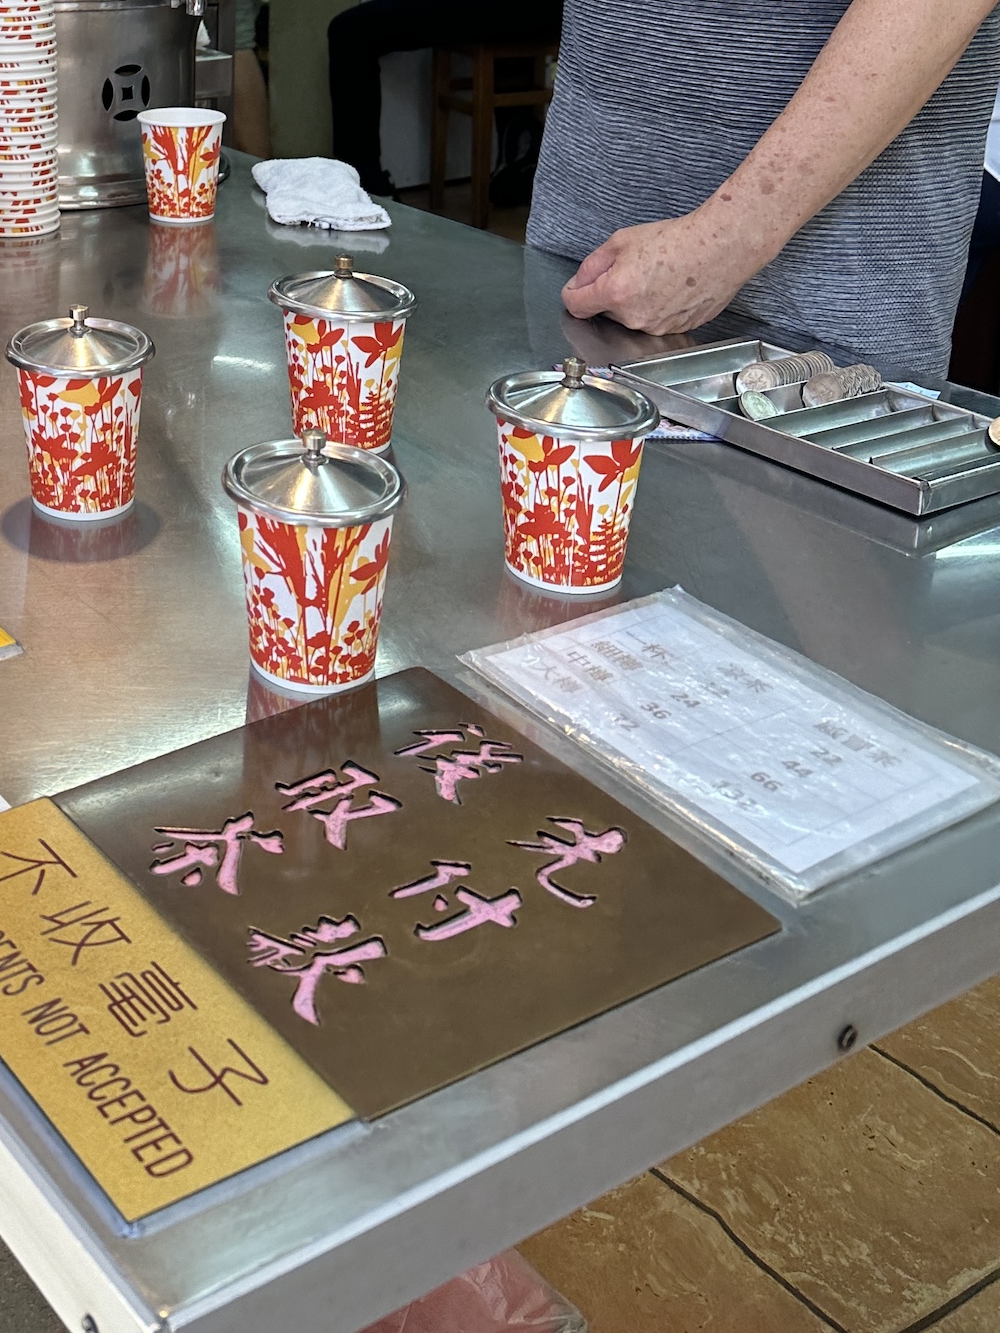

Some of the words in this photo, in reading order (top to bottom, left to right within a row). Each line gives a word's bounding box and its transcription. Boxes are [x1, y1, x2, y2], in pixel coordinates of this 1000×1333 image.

[670, 691, 702, 708] 24
[639, 702, 671, 720] 36
[750, 770, 783, 792] 66
[21, 997, 91, 1046] NOT
[62, 1052, 194, 1179] ACCEPTED
